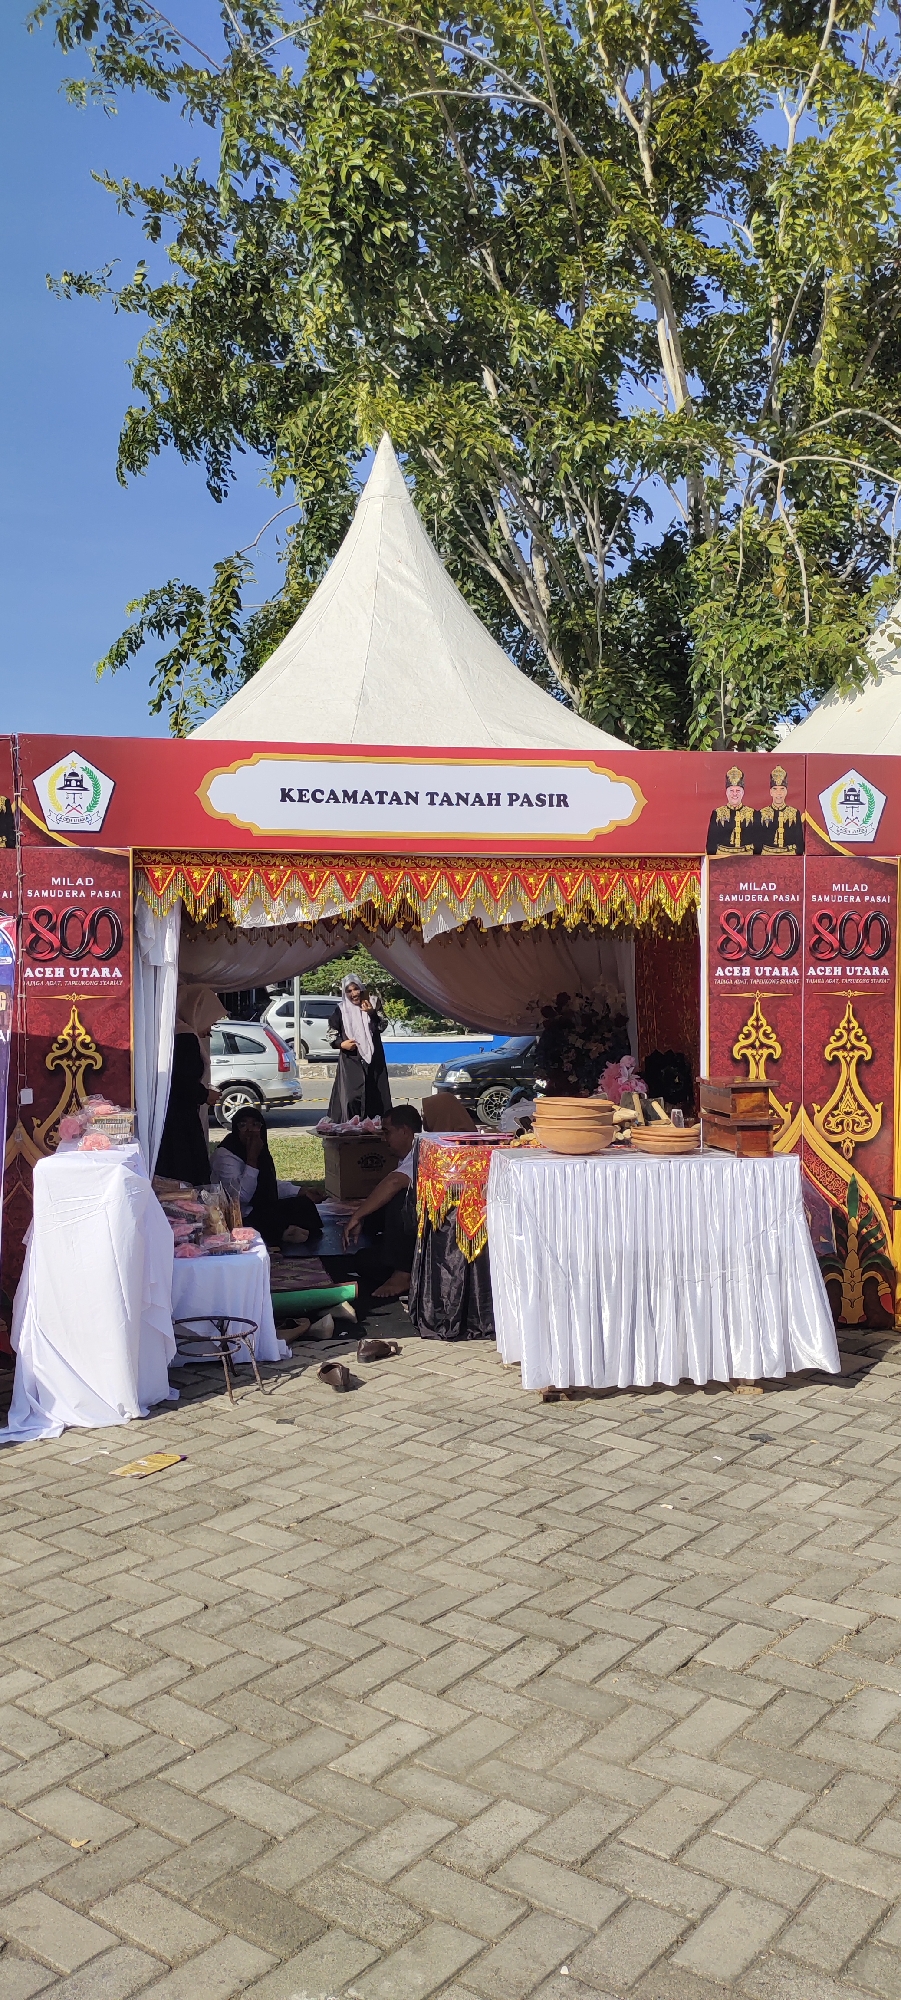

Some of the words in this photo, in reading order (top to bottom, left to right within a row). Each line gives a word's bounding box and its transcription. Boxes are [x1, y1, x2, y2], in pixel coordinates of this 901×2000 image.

[279, 787, 420, 806] KECAMATAN
[425, 791, 502, 807] TANAH
[506, 792, 570, 808] PASIR
[51, 877, 94, 886] MILAD
[739, 882, 777, 891] MILAD
[832, 883, 869, 892] MILAD
[26, 889, 86, 898] SAMUDERA
[90, 890, 121, 899] PASAI
[718, 893, 770, 902] SAMUDERA
[773, 894, 800, 902] PASAI
[811, 894, 861, 903] SAMUDERA
[864, 895, 891, 904] PASAI
[25, 905, 123, 961] 800
[717, 908, 800, 961] 800
[808, 908, 891, 961] 800
[24, 967, 65, 978] ACEH
[69, 967, 123, 978] UTARA
[714, 966, 751, 977] ACEH
[754, 966, 800, 977] UTARA
[806, 966, 843, 976] ACEH
[845, 966, 890, 976] UTARA
